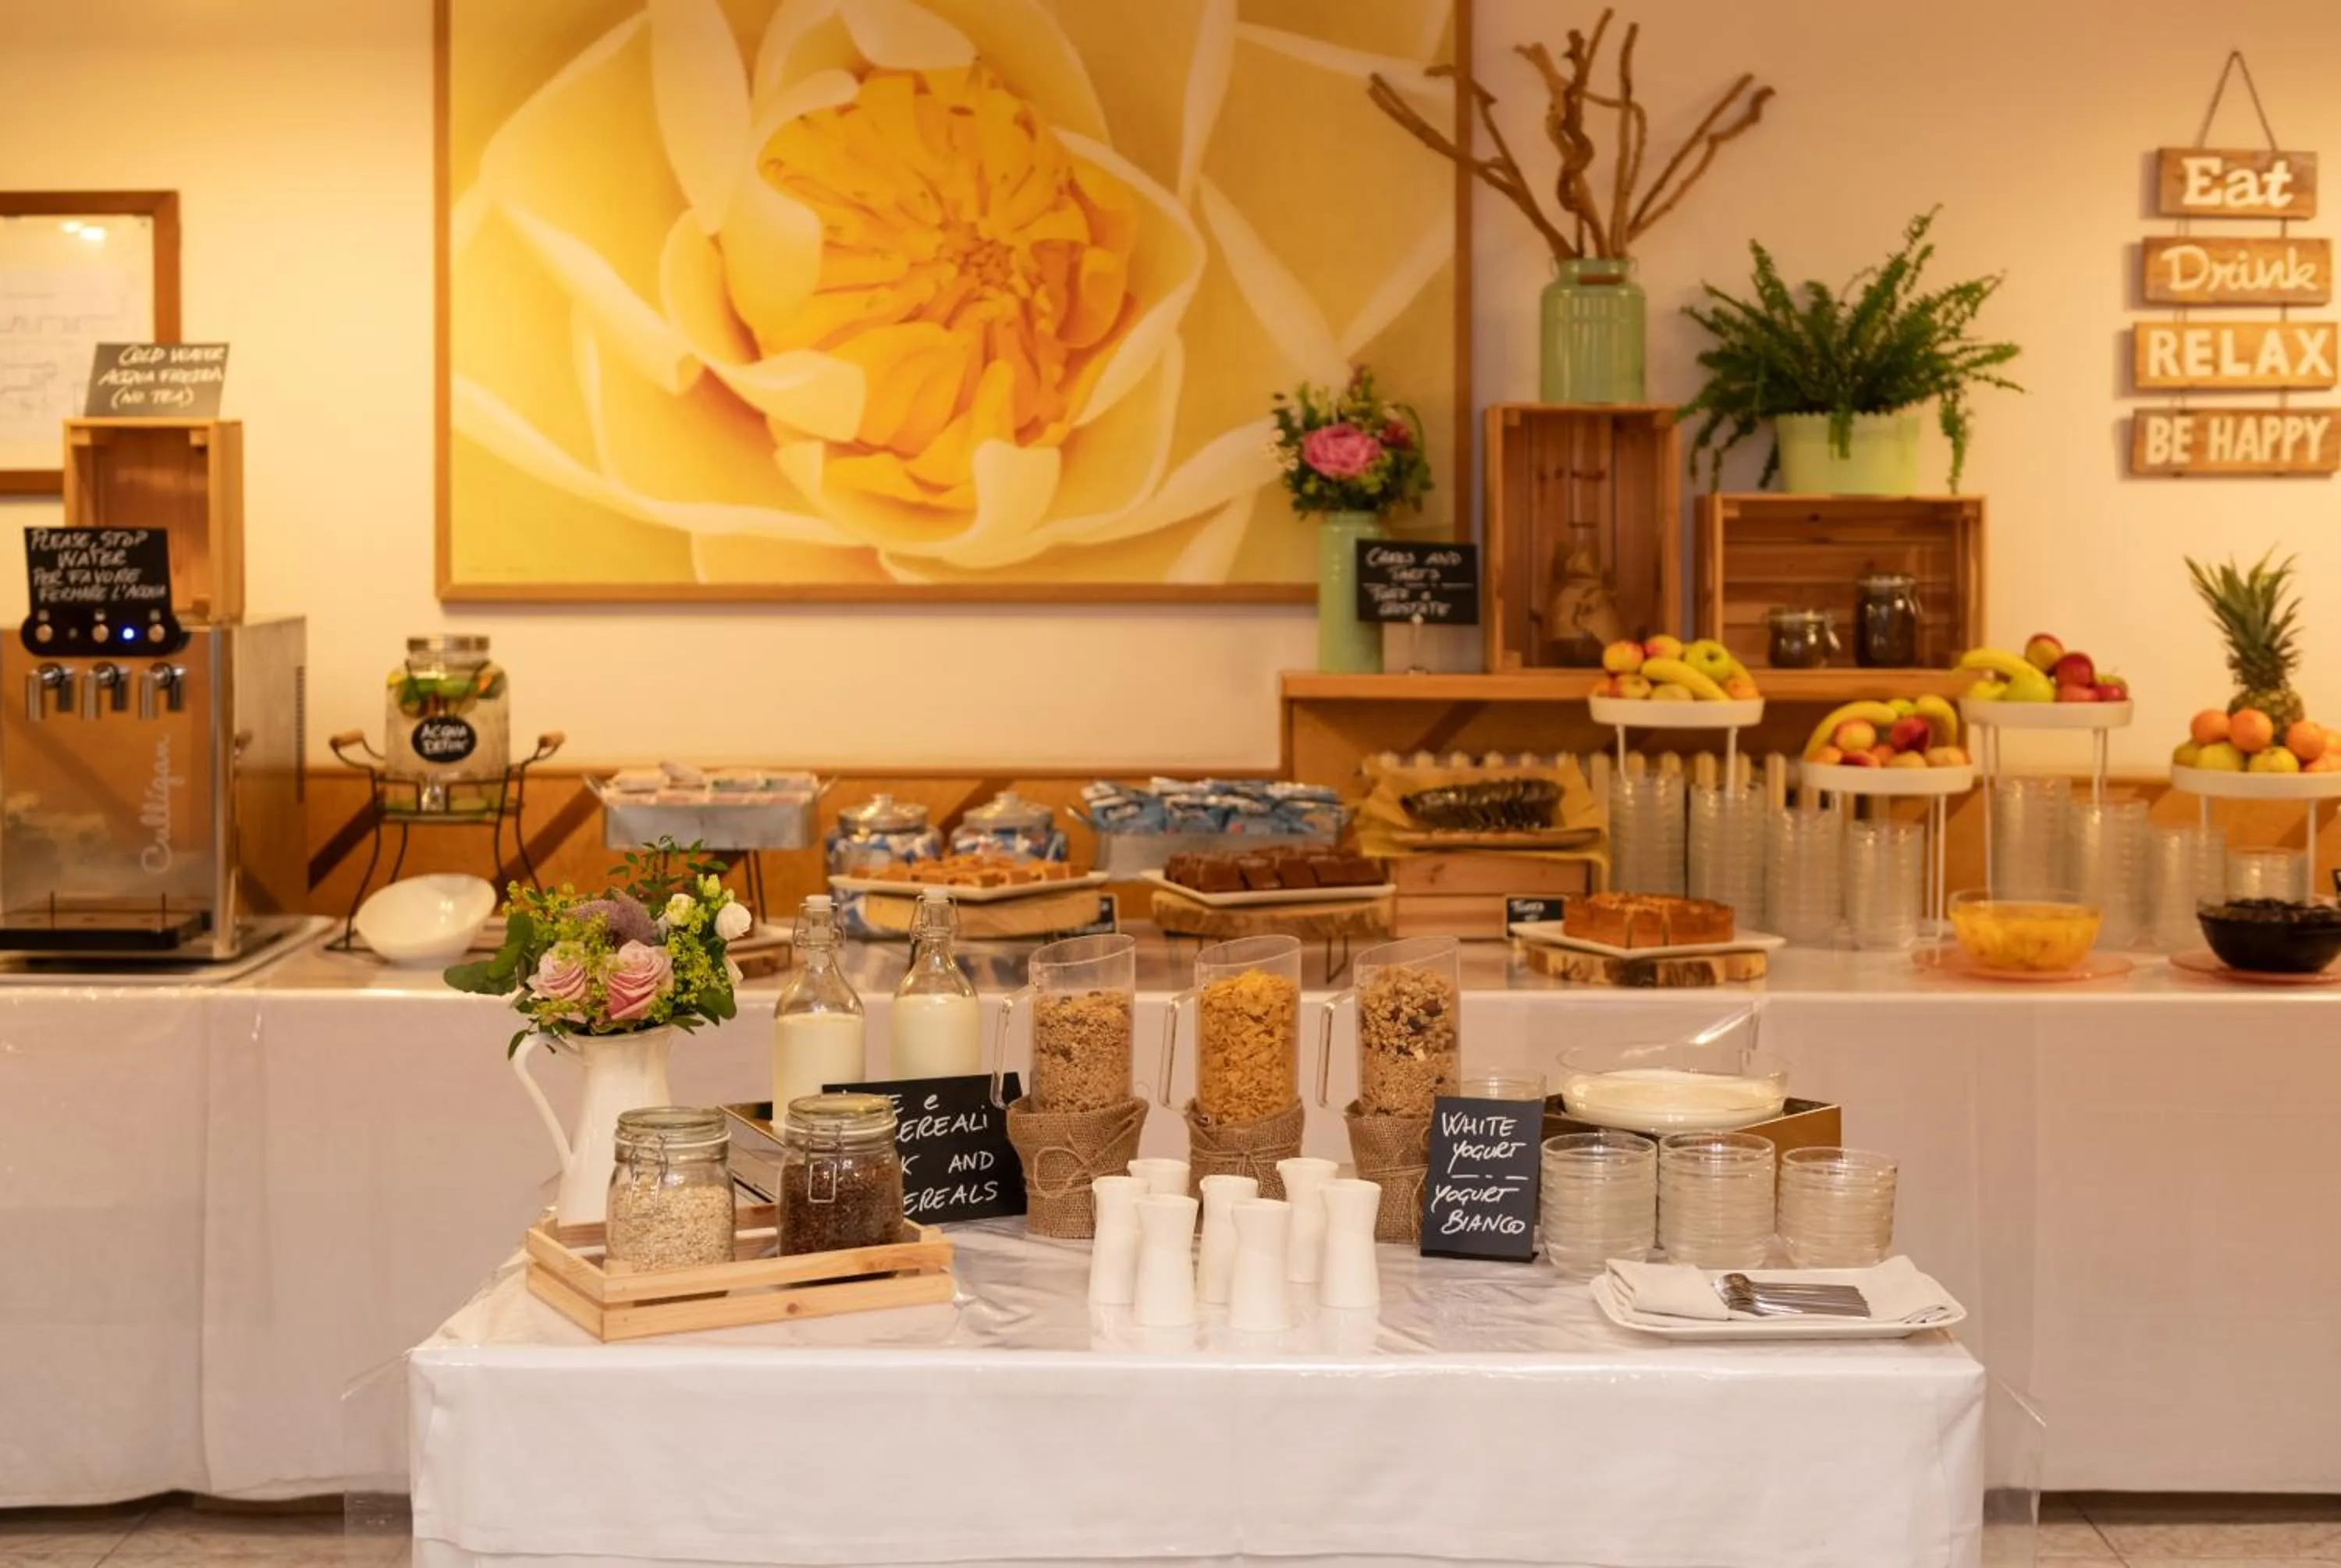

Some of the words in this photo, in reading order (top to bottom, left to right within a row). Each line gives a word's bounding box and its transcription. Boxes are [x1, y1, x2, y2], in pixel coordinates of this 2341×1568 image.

[2182, 157, 2294, 208] Eat
[2161, 245, 2318, 292] Drink
[119, 345, 166, 367] COLD
[170, 346, 225, 364] WATER
[2148, 328, 2332, 378] RELAX
[2145, 416, 2194, 466] BE
[2208, 415, 2331, 463] HAPPY
[31, 529, 91, 551] PLEASE
[100, 530, 149, 547] STOP
[57, 543, 127, 568] WATER
[33, 566, 63, 586] PER
[67, 568, 142, 584] FAVORE
[140, 733, 186, 874] Culligan
[895, 1105, 988, 1143] EREALi
[1441, 1112, 1518, 1137] WHITE
[948, 1151, 995, 1173] AND
[1447, 1140, 1527, 1174] YOGURT
[902, 1181, 999, 1215] EREALS
[1430, 1184, 1520, 1213] YOGURT
[1440, 1209, 1526, 1235] BIANCO
